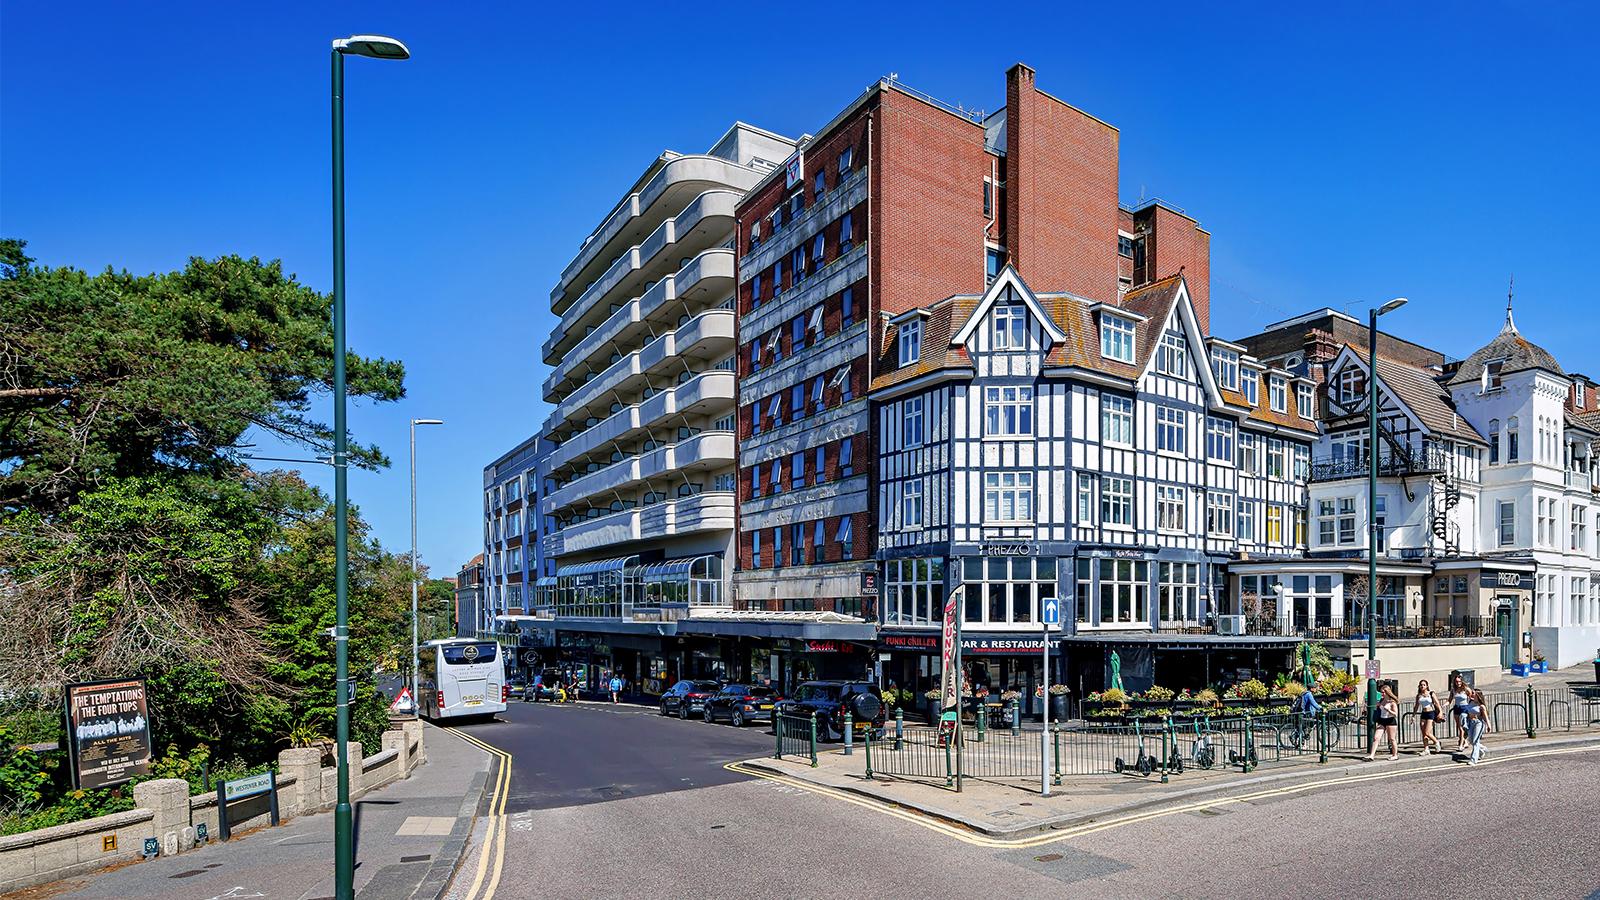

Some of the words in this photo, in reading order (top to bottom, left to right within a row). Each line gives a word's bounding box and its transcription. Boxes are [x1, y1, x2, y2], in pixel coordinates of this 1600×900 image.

[988, 543, 1030, 555] PREZZO
[1498, 572, 1520, 586] PREZZO
[809, 641, 834, 651] Sushi
[886, 637, 905, 646] FUNKI
[907, 635, 936, 647] GRILLER
[945, 615, 953, 672] FUNKI
[981, 641, 988, 649] &
[991, 641, 1060, 649] RESTAURANT
[73, 695, 89, 707] THE
[90, 689, 143, 705] TEMPTATIONS
[81, 706, 97, 718] THE
[97, 703, 118, 716] FOUR
[118, 701, 138, 712] TOPS
[199, 827, 206, 835] SV
[104, 836, 115, 849] H
